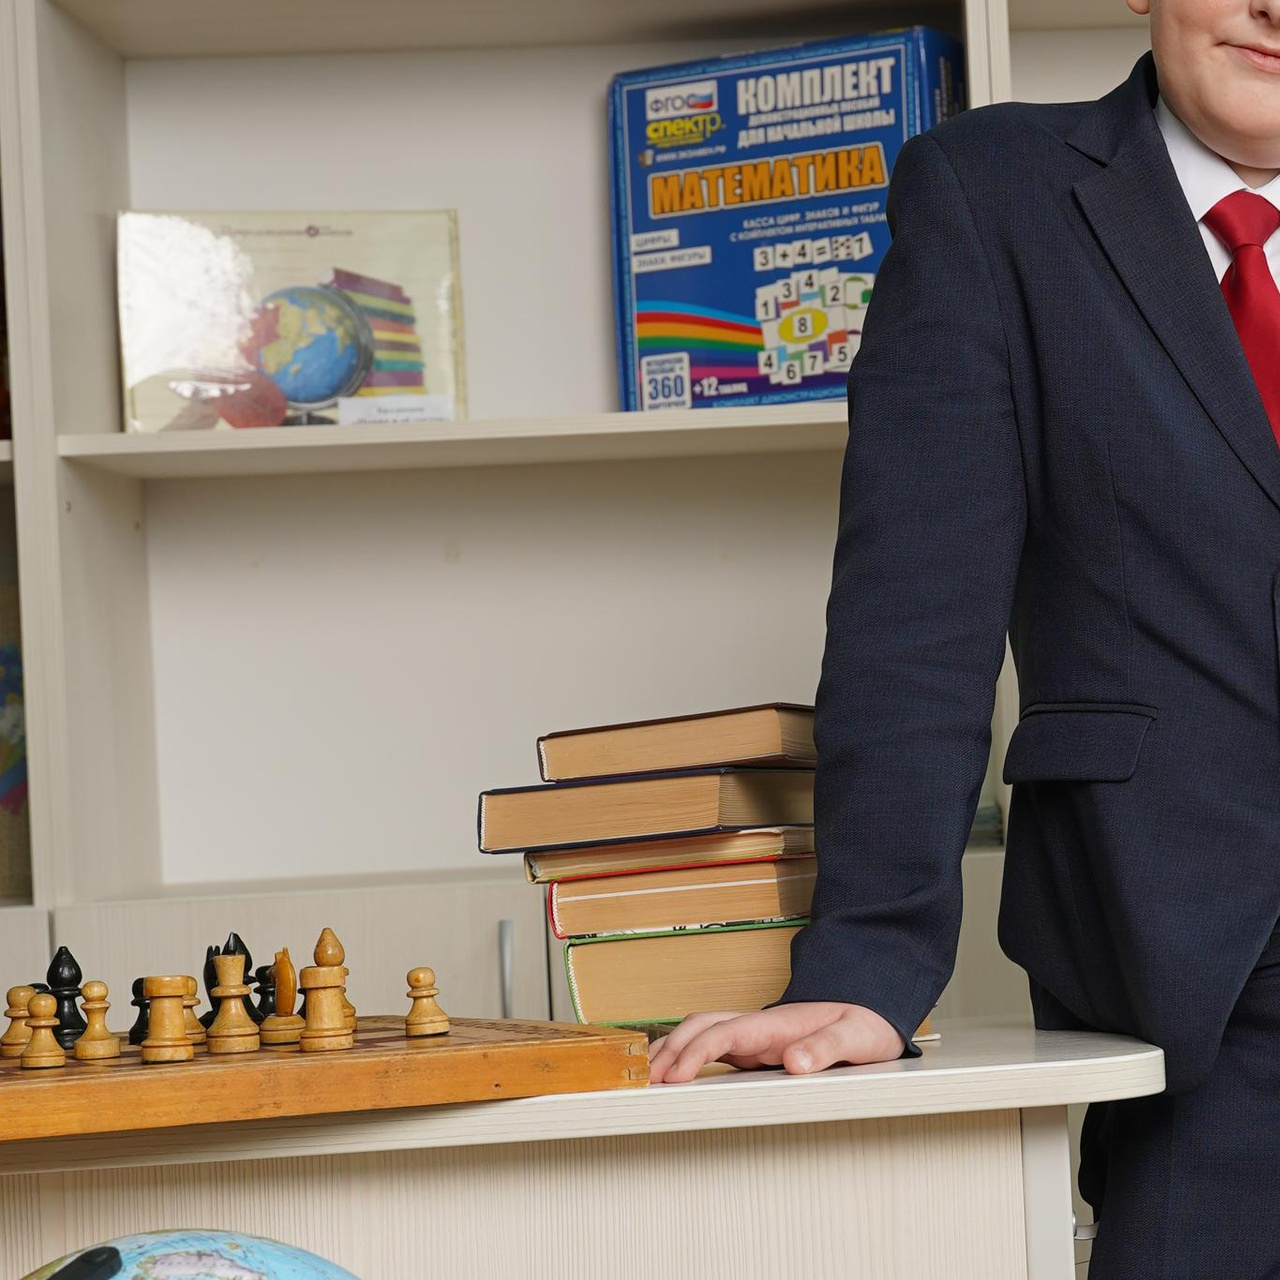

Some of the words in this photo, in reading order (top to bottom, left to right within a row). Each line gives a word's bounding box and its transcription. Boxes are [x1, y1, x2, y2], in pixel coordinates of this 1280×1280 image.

[736, 57, 896, 115] КОМПЛЕКТ
[737, 128, 765, 149] ДЛЯ
[767, 115, 842, 142] НАЧАЛЬНОЙ
[843, 108, 895, 132] ШКОЛЫ
[650, 143, 887, 217] МАТЕМАТИКА
[759, 250, 769, 267] 3
[797, 243, 807, 259] 4
[855, 237, 864, 254] 7
[804, 273, 814, 289] 4
[782, 282, 792, 299] 3
[830, 285, 840, 302] 2
[762, 300, 769, 316] 1
[798, 317, 808, 333] 8
[763, 353, 773, 369] 4
[837, 346, 847, 362] 5
[808, 355, 818, 371] 7
[786, 364, 796, 380] 6
[649, 375, 684, 400] 360
[693, 376, 719, 397] +12
